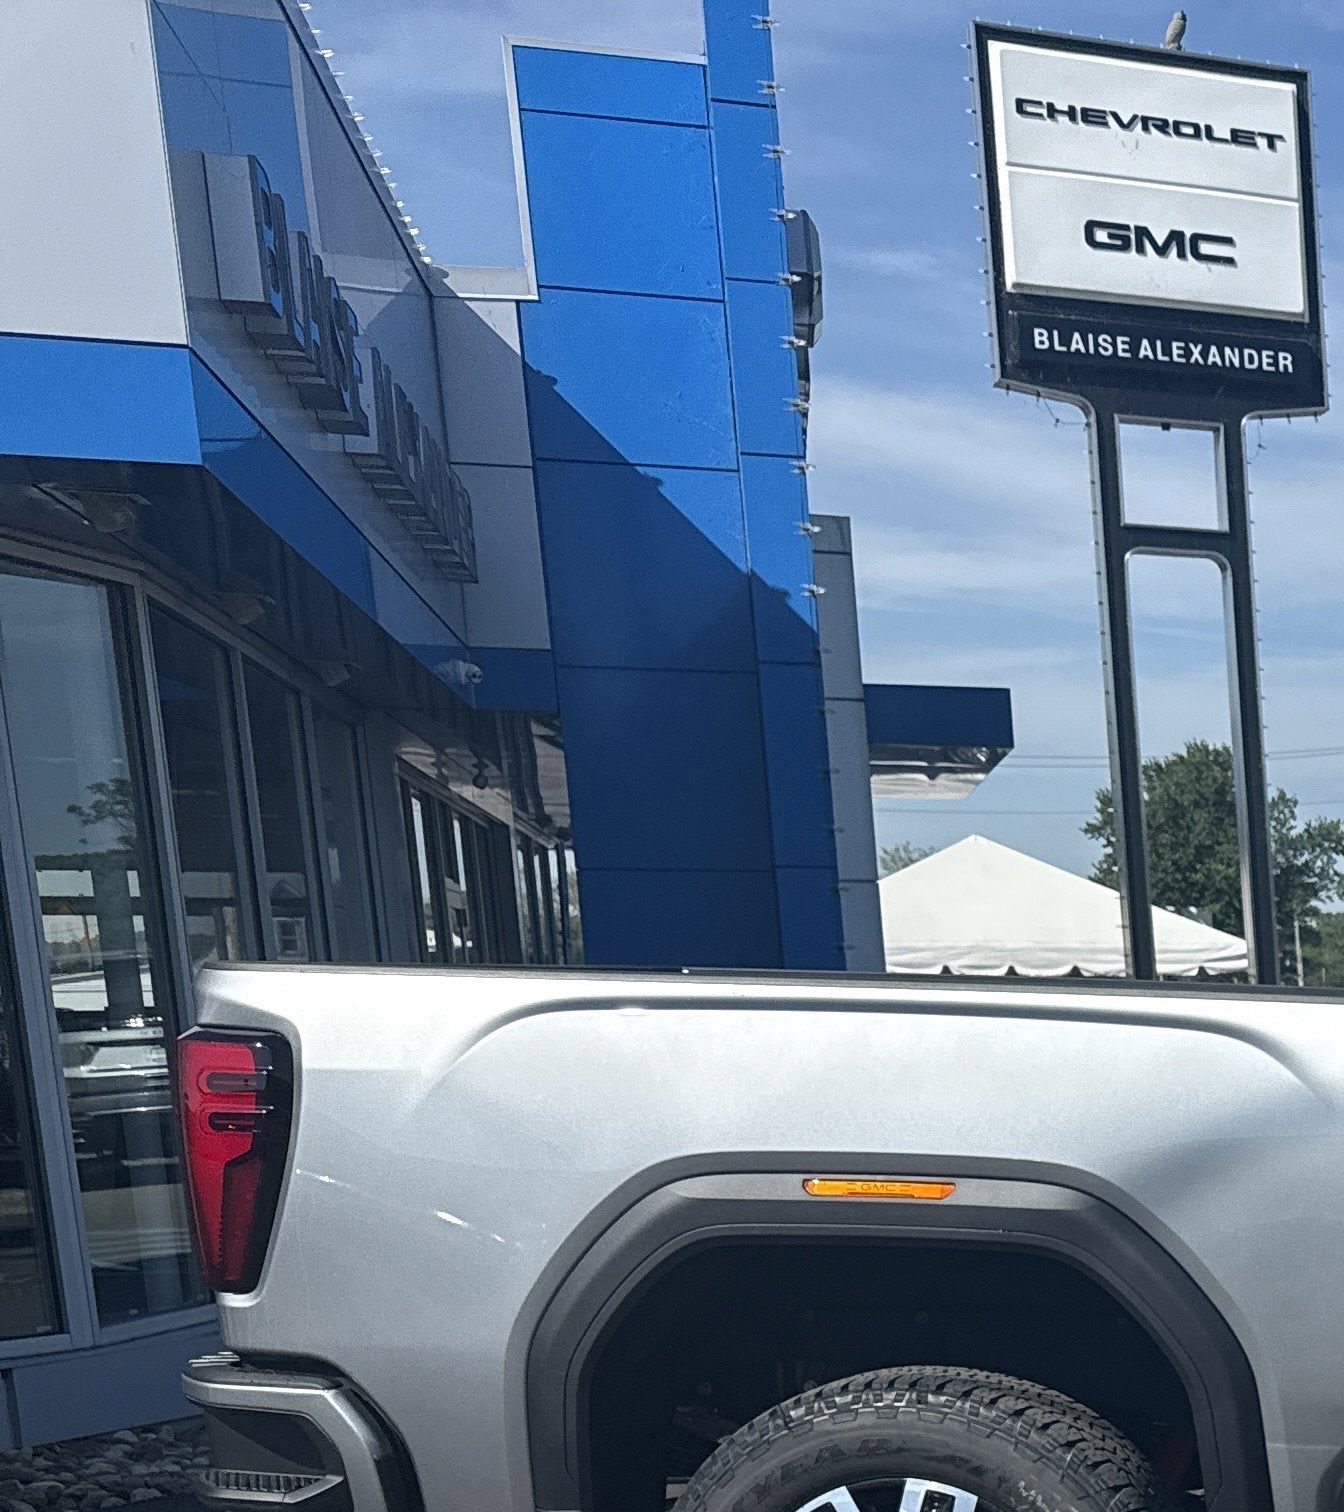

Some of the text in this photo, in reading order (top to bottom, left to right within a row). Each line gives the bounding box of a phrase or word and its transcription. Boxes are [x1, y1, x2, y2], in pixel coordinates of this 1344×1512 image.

[1014, 97, 1286, 152] CHEVROLET
[1084, 219, 1237, 268] GMC
[1033, 327, 1294, 374] BLAISE ALEXANDER
